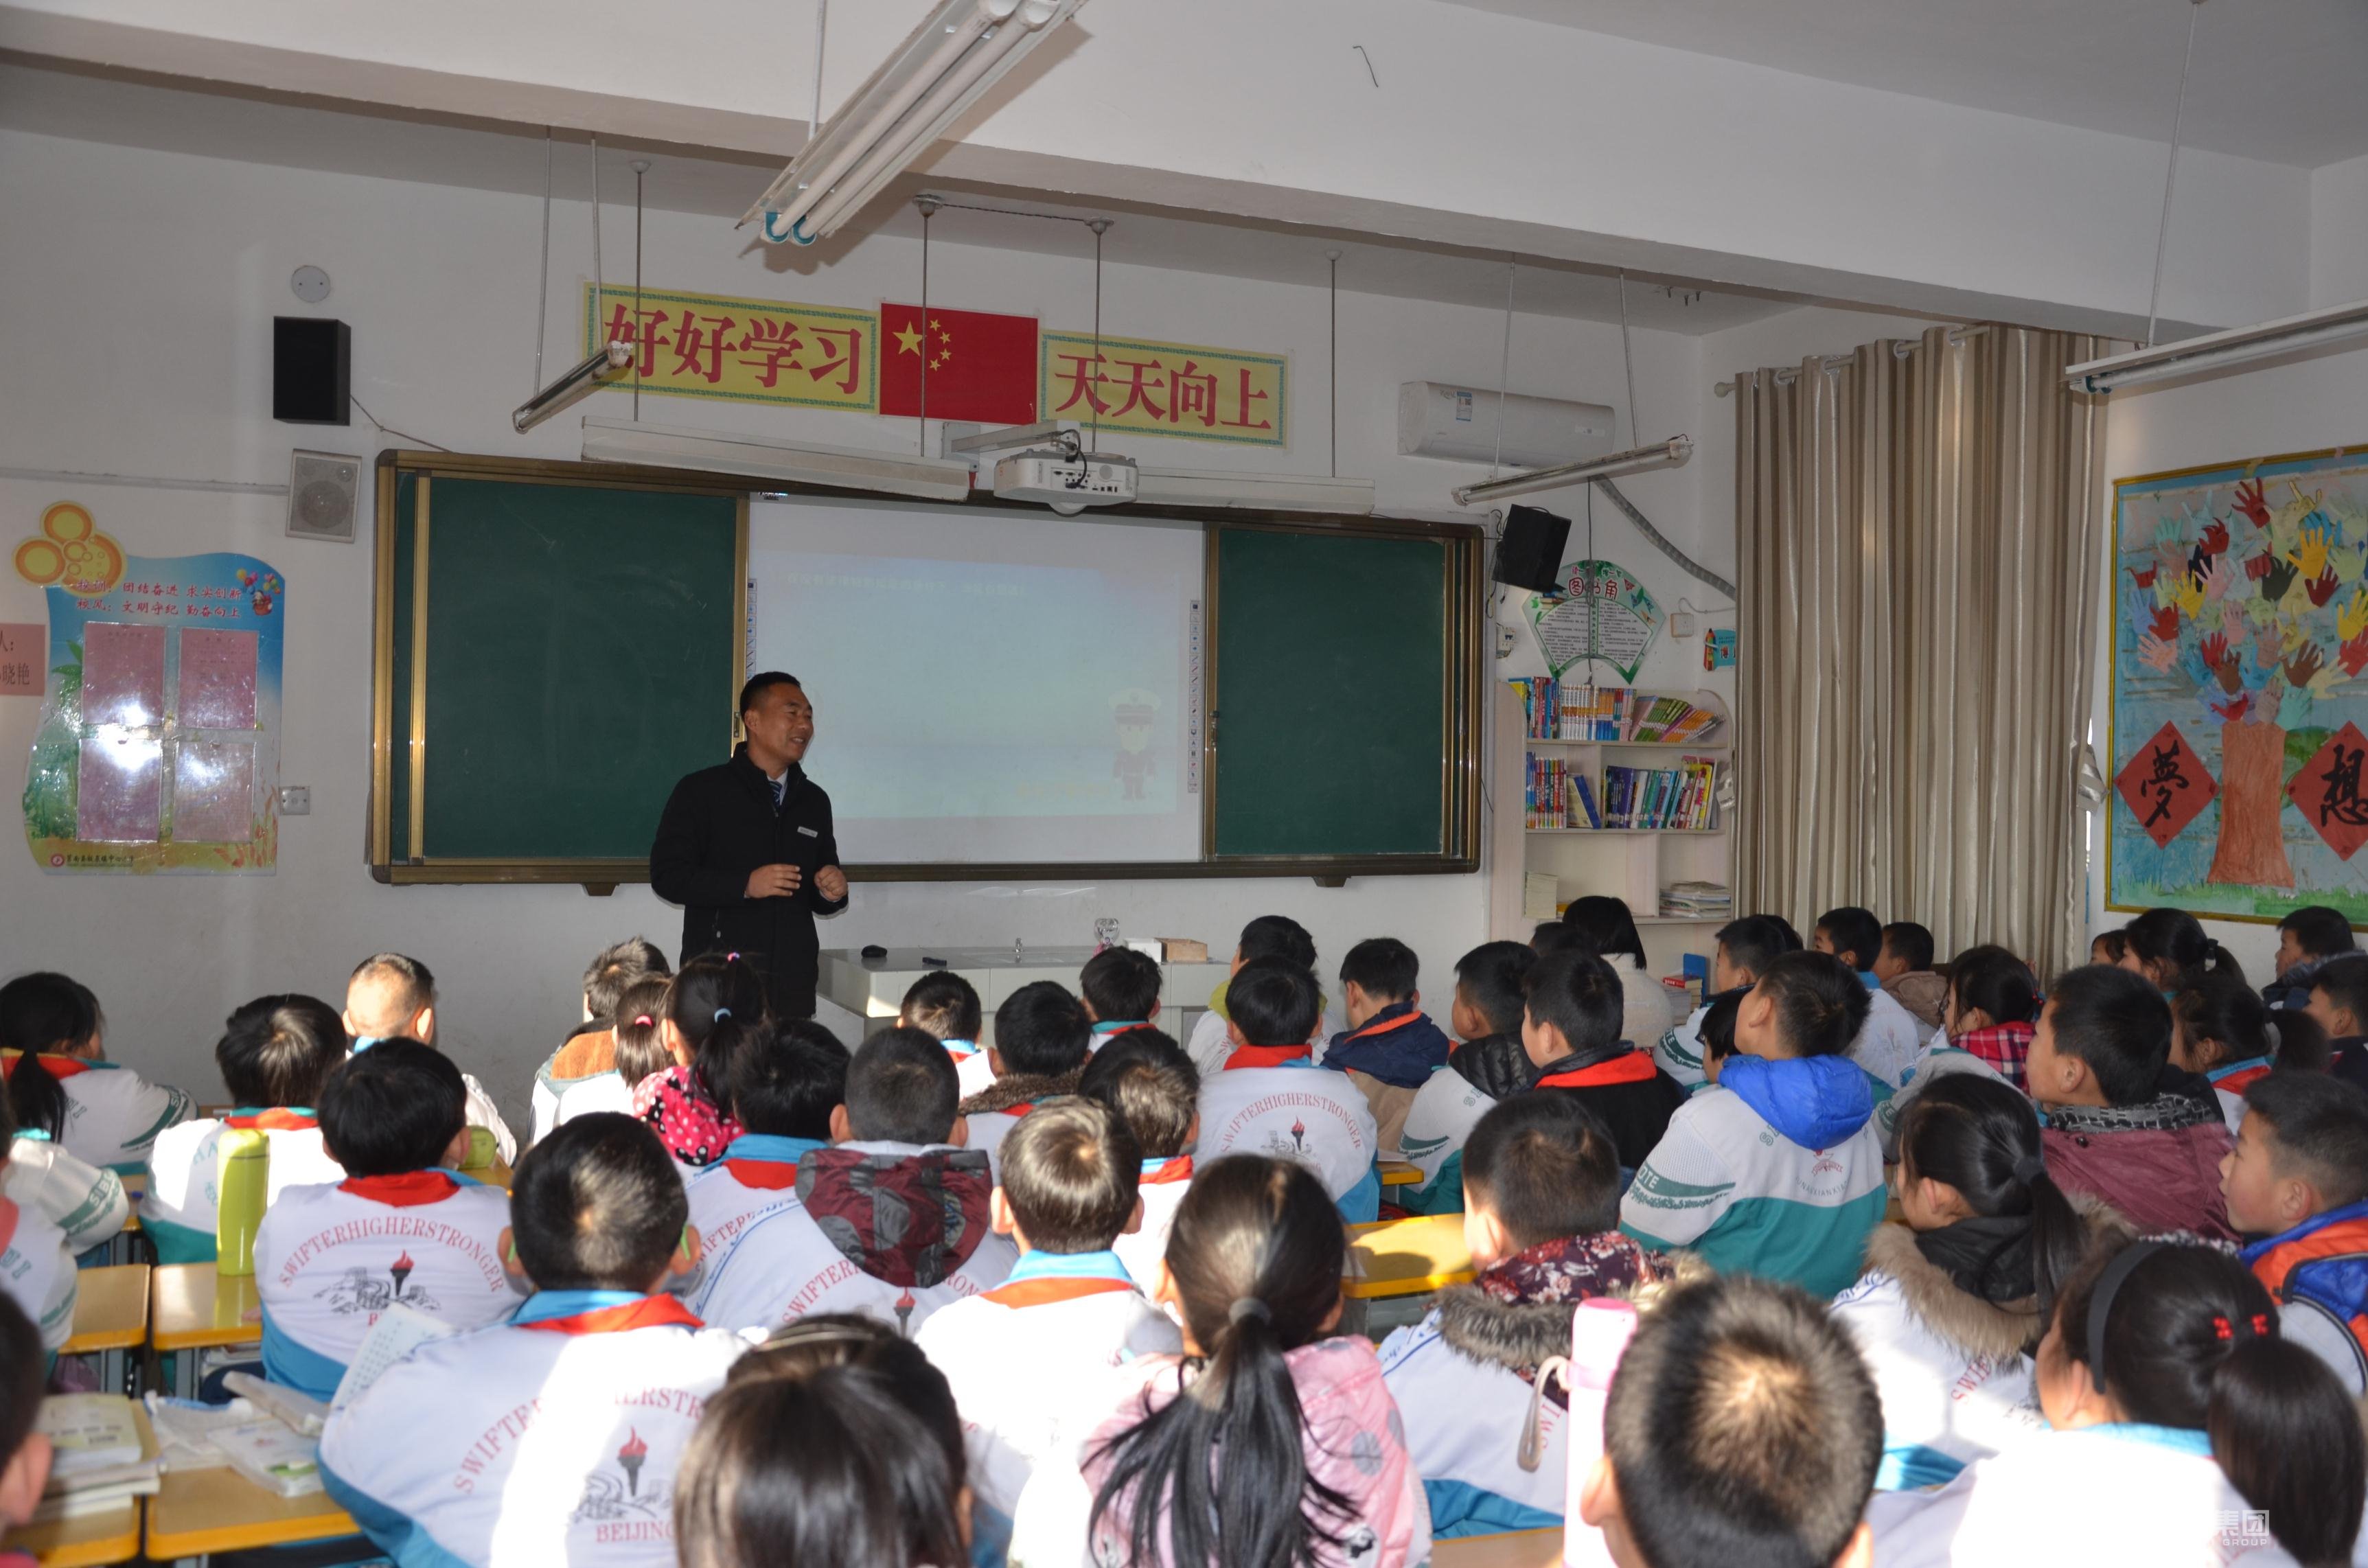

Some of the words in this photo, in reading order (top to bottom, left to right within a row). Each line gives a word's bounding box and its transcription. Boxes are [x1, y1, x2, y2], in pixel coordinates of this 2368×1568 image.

[605, 302, 864, 395] 好好学习
[1055, 354, 1272, 431] 天天向上
[279, 1215, 505, 1293] SWIFTERHIGHERSTRONGER
